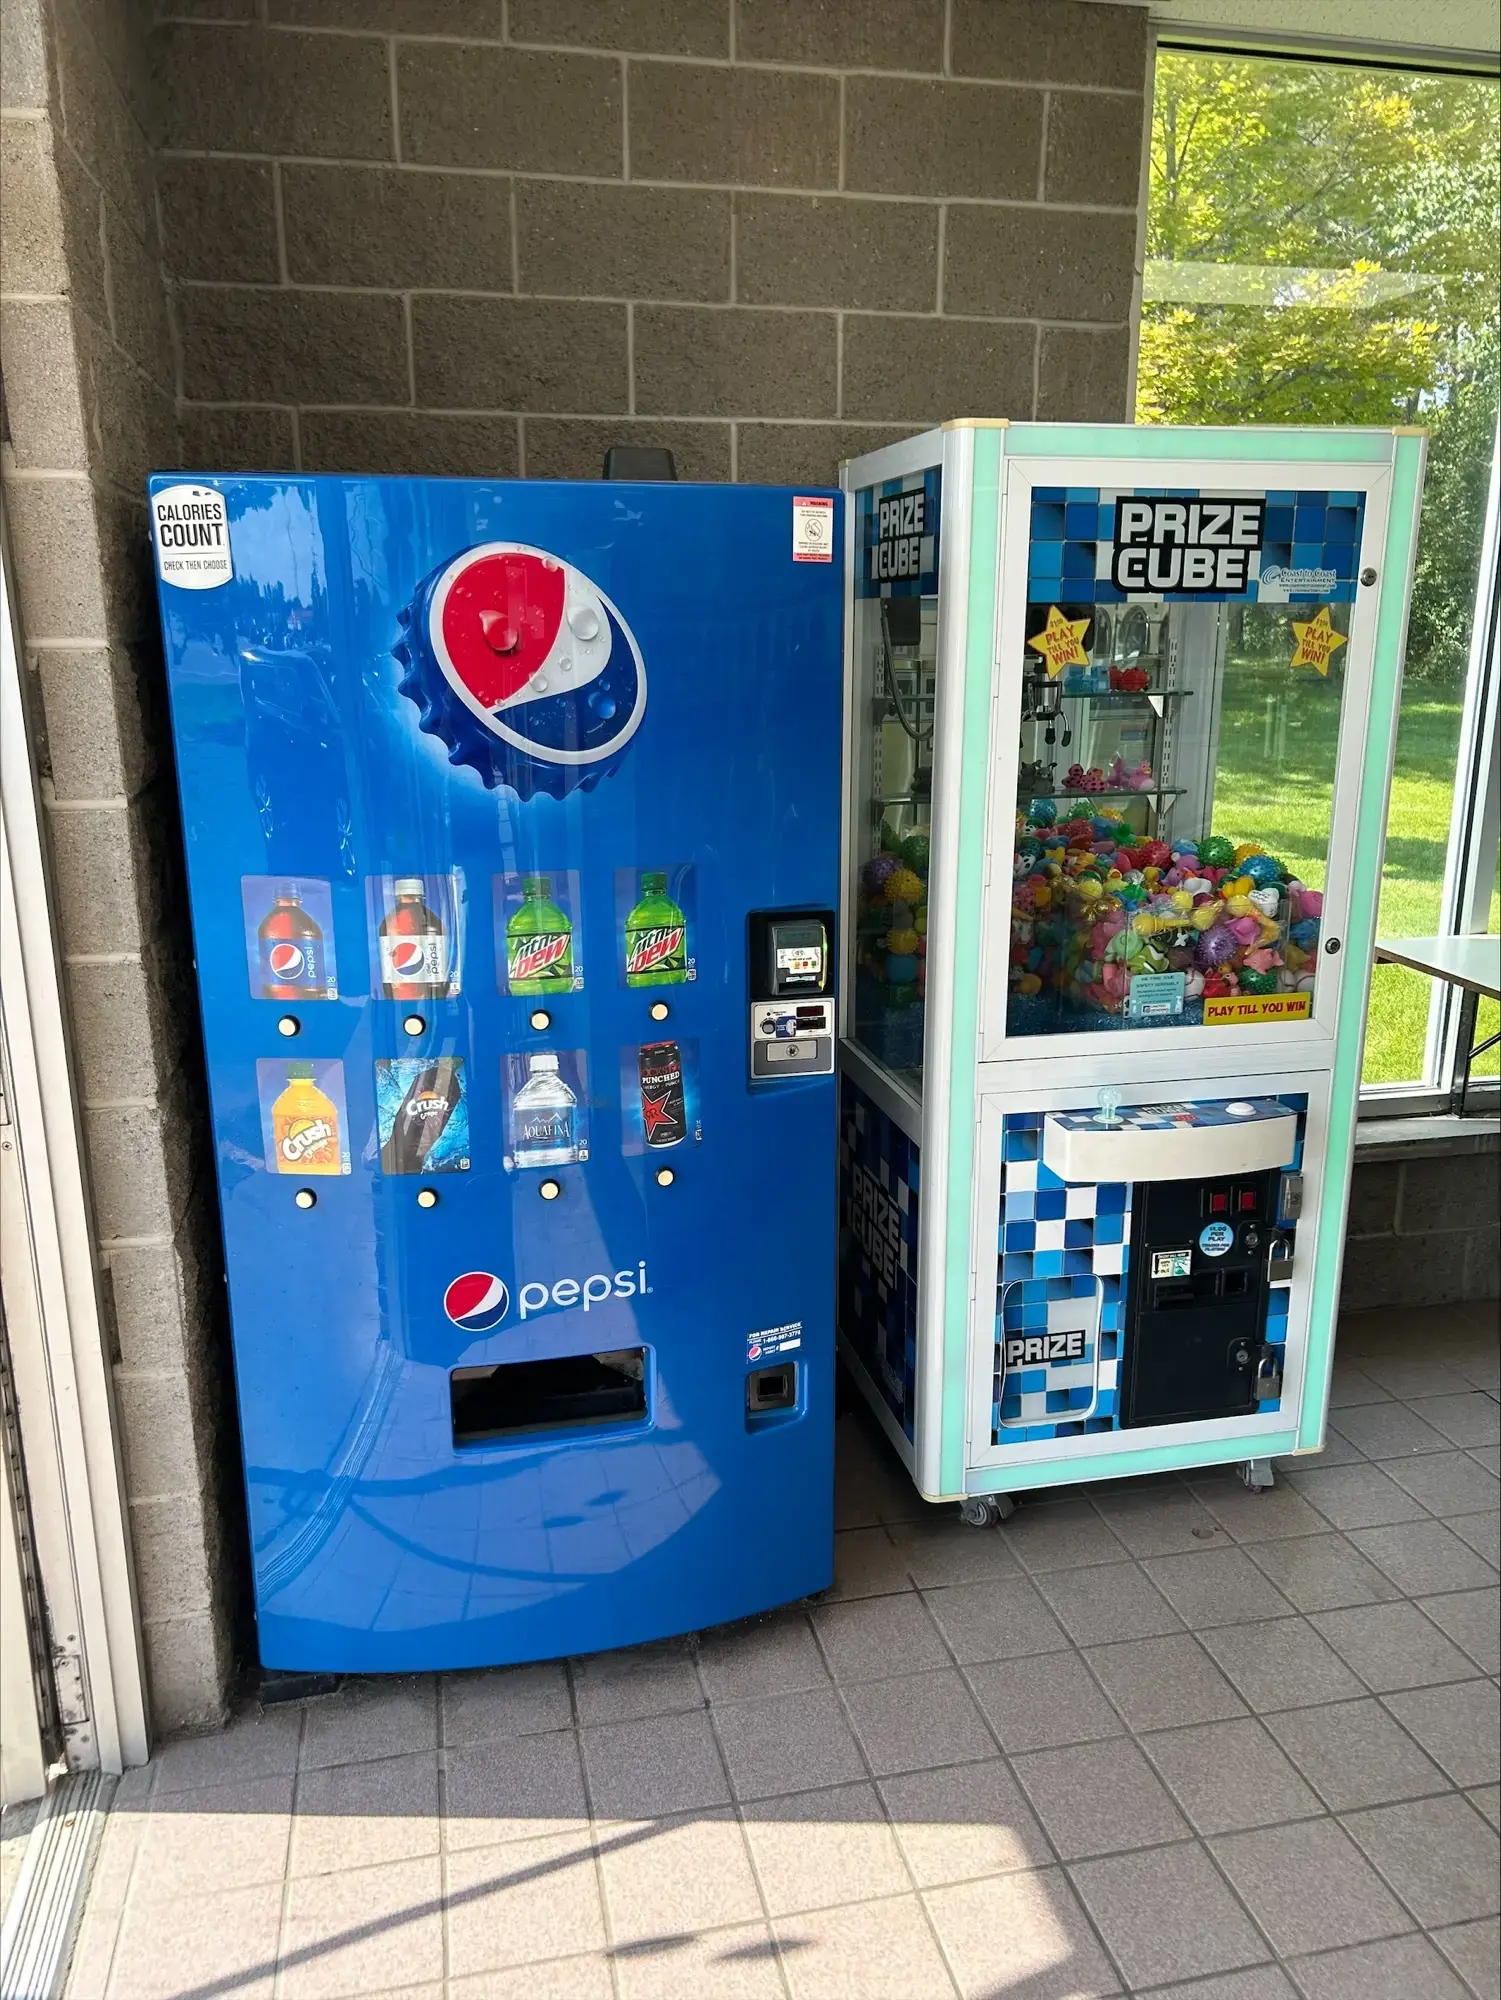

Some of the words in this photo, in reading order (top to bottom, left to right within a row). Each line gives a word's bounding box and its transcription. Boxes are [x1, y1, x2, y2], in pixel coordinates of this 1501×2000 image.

[158, 504, 222, 521] CALORIES
[880, 493, 924, 539] PRIZE
[1120, 503, 1261, 544] PRIZE
[160, 523, 223, 547] COUNT
[164, 561, 184, 571] CHECK
[186, 561, 201, 570] THEN
[203, 559, 228, 570] CHOOSE
[880, 537, 919, 577] CUBE
[1117, 548, 1245, 589] CUBE
[1045, 624, 1075, 646] PLAY
[1047, 643, 1063, 655] TILL
[1065, 636, 1079, 648] YOU
[1302, 638, 1315, 651] TILL
[1318, 643, 1331, 653] YOU
[1305, 626, 1333, 645] PLAY
[1052, 646, 1079, 665] WIN!
[1302, 647, 1325, 665] WIN!
[304, 945, 316, 978] pepsi
[428, 943, 439, 975] pepsi
[1208, 1007, 1234, 1017] PLAY
[1237, 1005, 1258, 1015] TILL
[1261, 1002, 1283, 1013] YOU
[1287, 1001, 1306, 1011] WIN
[642, 1071, 680, 1084] PUNCHED
[406, 1096, 449, 1116] Crush
[282, 1120, 332, 1160] Crush
[523, 1121, 570, 1140] AQUAFINA
[853, 1161, 900, 1252] PRIZE
[852, 1205, 895, 1290] CUBE
[519, 1260, 646, 1320] pepsi
[761, 1327, 779, 1335] REPAIR
[780, 1322, 801, 1332] SERVICE
[1008, 1333, 1082, 1364] PRIZE
